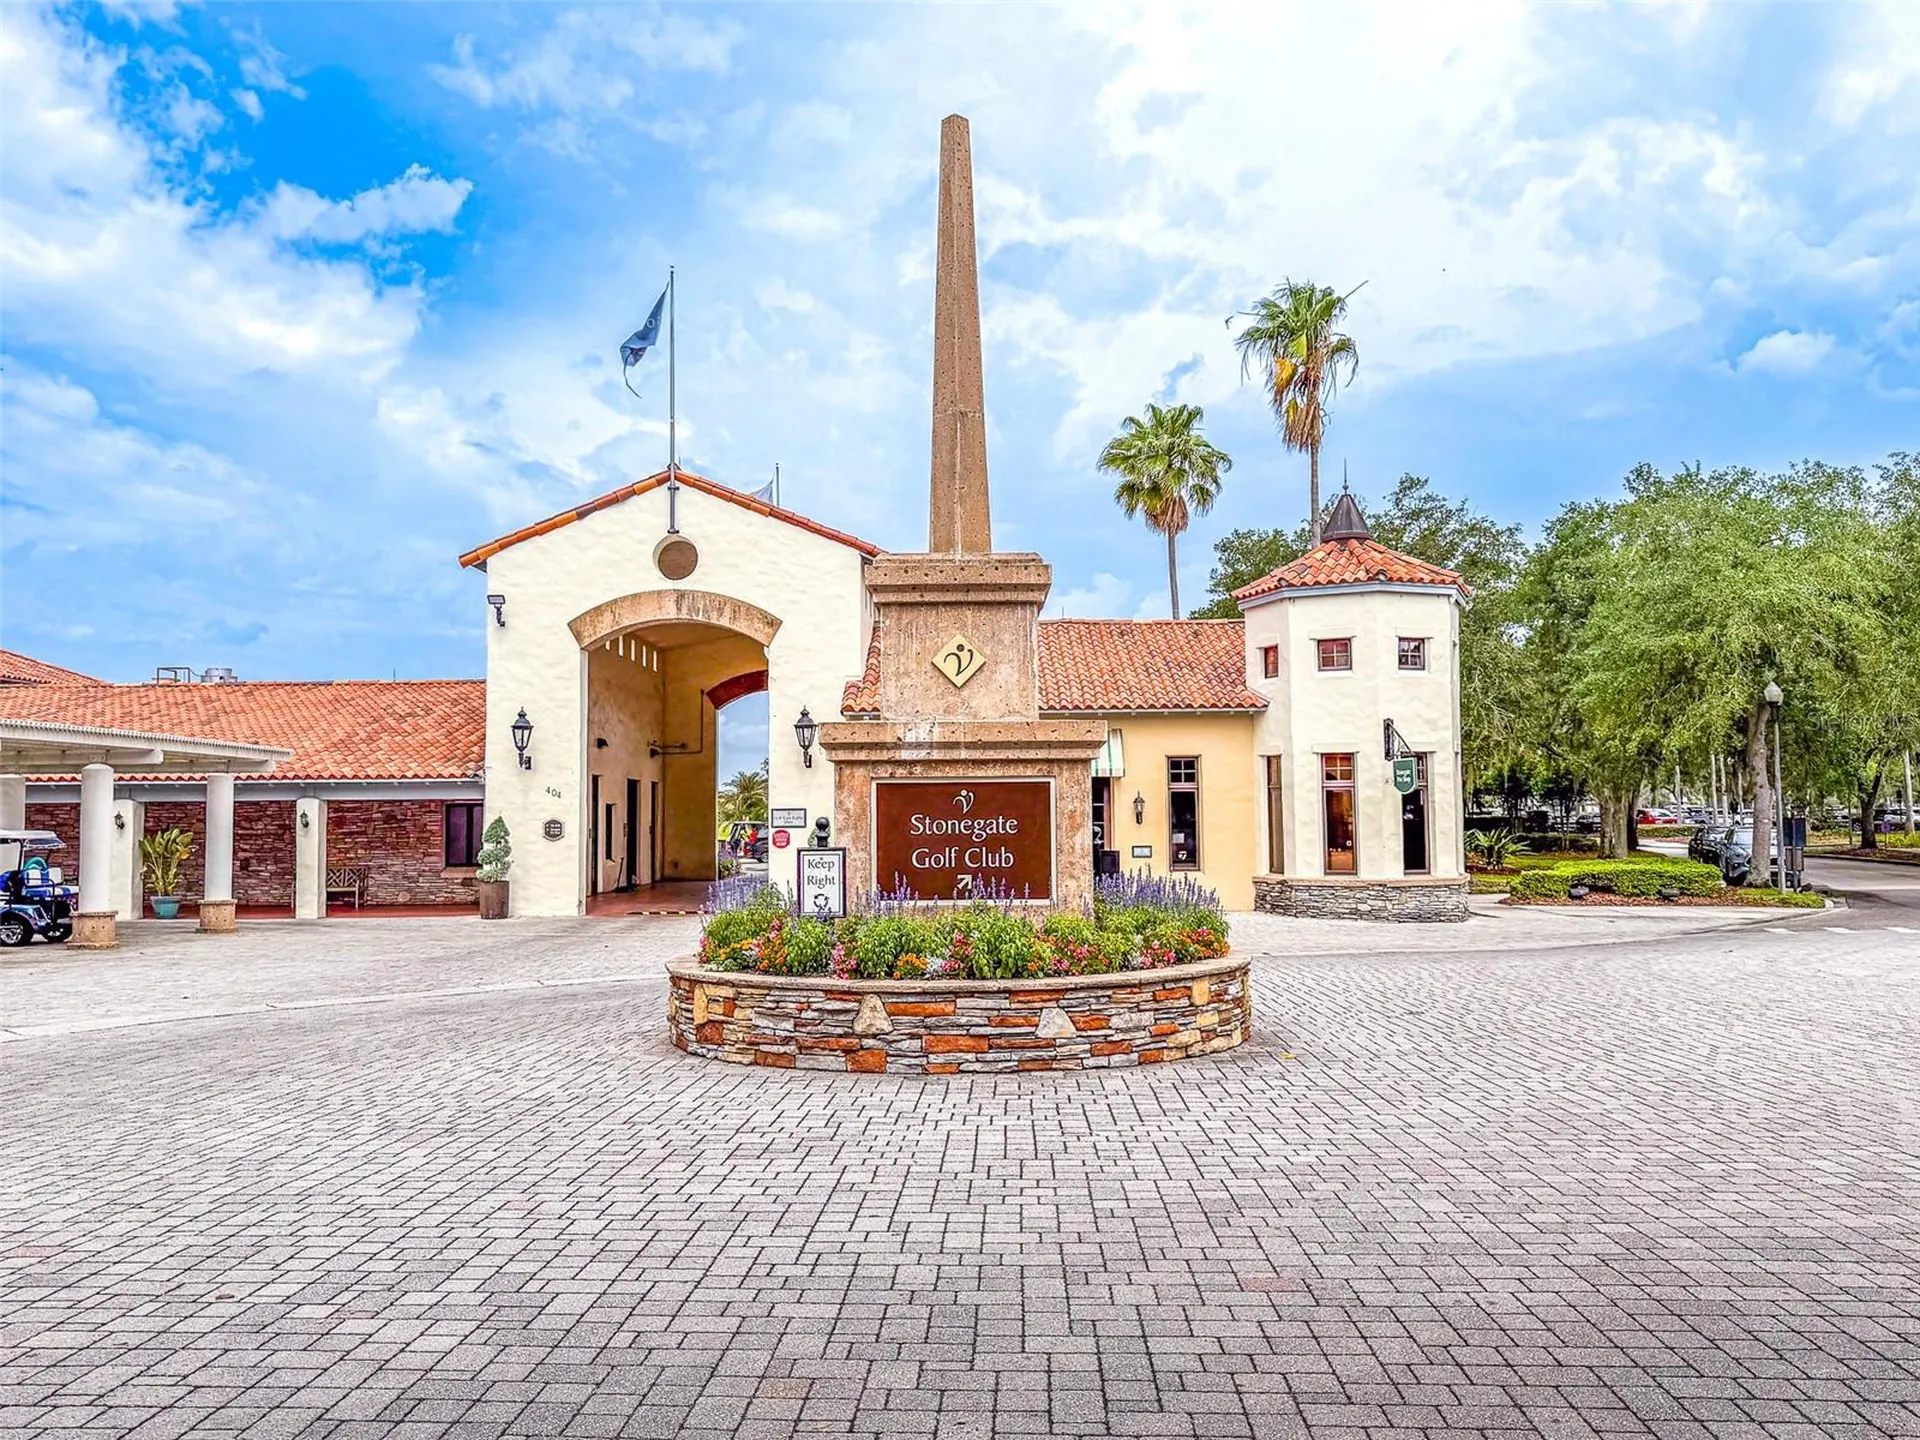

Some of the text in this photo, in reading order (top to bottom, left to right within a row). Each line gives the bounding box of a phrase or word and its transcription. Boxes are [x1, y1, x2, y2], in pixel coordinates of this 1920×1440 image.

[545, 786, 561, 799] 404
[910, 814, 1018, 842] Stonegate
[911, 846, 1014, 869] Golf Club
[807, 859, 835, 873] Keep
[807, 875, 836, 889] Right
